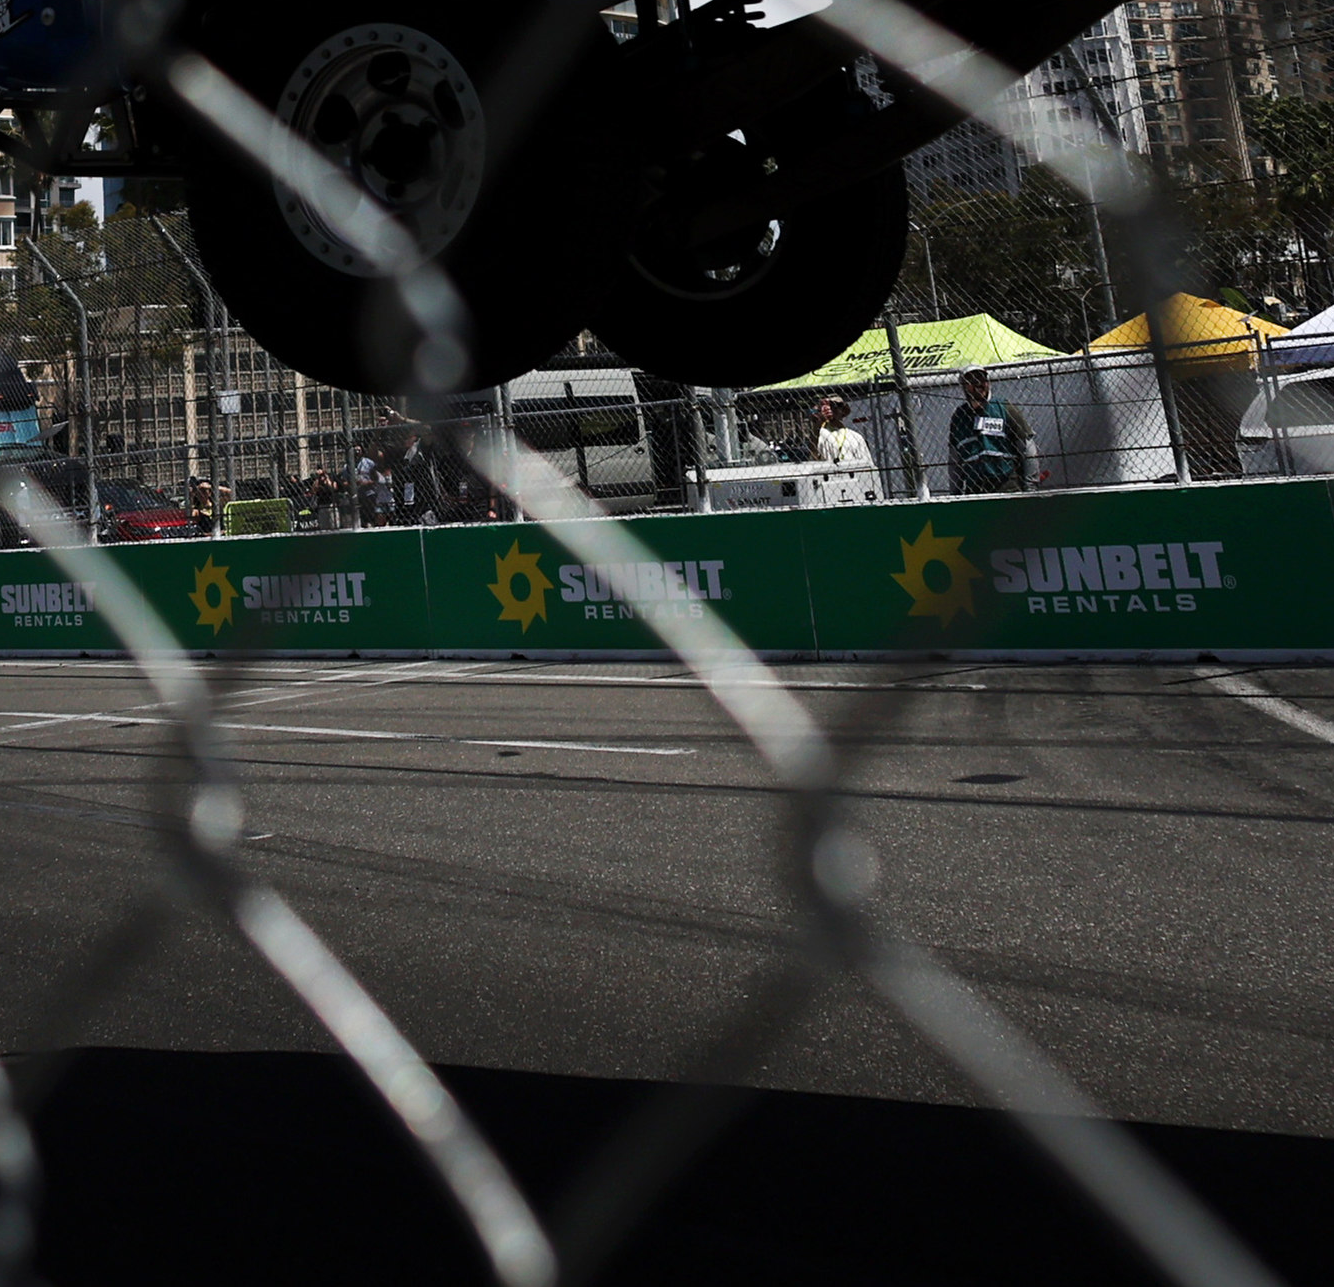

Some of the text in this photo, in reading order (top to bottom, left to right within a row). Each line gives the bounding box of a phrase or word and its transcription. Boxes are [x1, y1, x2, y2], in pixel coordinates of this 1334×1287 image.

[846, 341, 955, 361] MORINGS
[990, 541, 1223, 593] SUNBELT
[242, 572, 366, 609] SUNBELT
[559, 560, 724, 602] SUNBELT
[0, 582, 96, 613] SUNBELT
[1028, 594, 1197, 614] RENTALS
[14, 614, 83, 628] RENTALS
[261, 610, 350, 624] RENTALS
[585, 604, 703, 619] RENTALS
